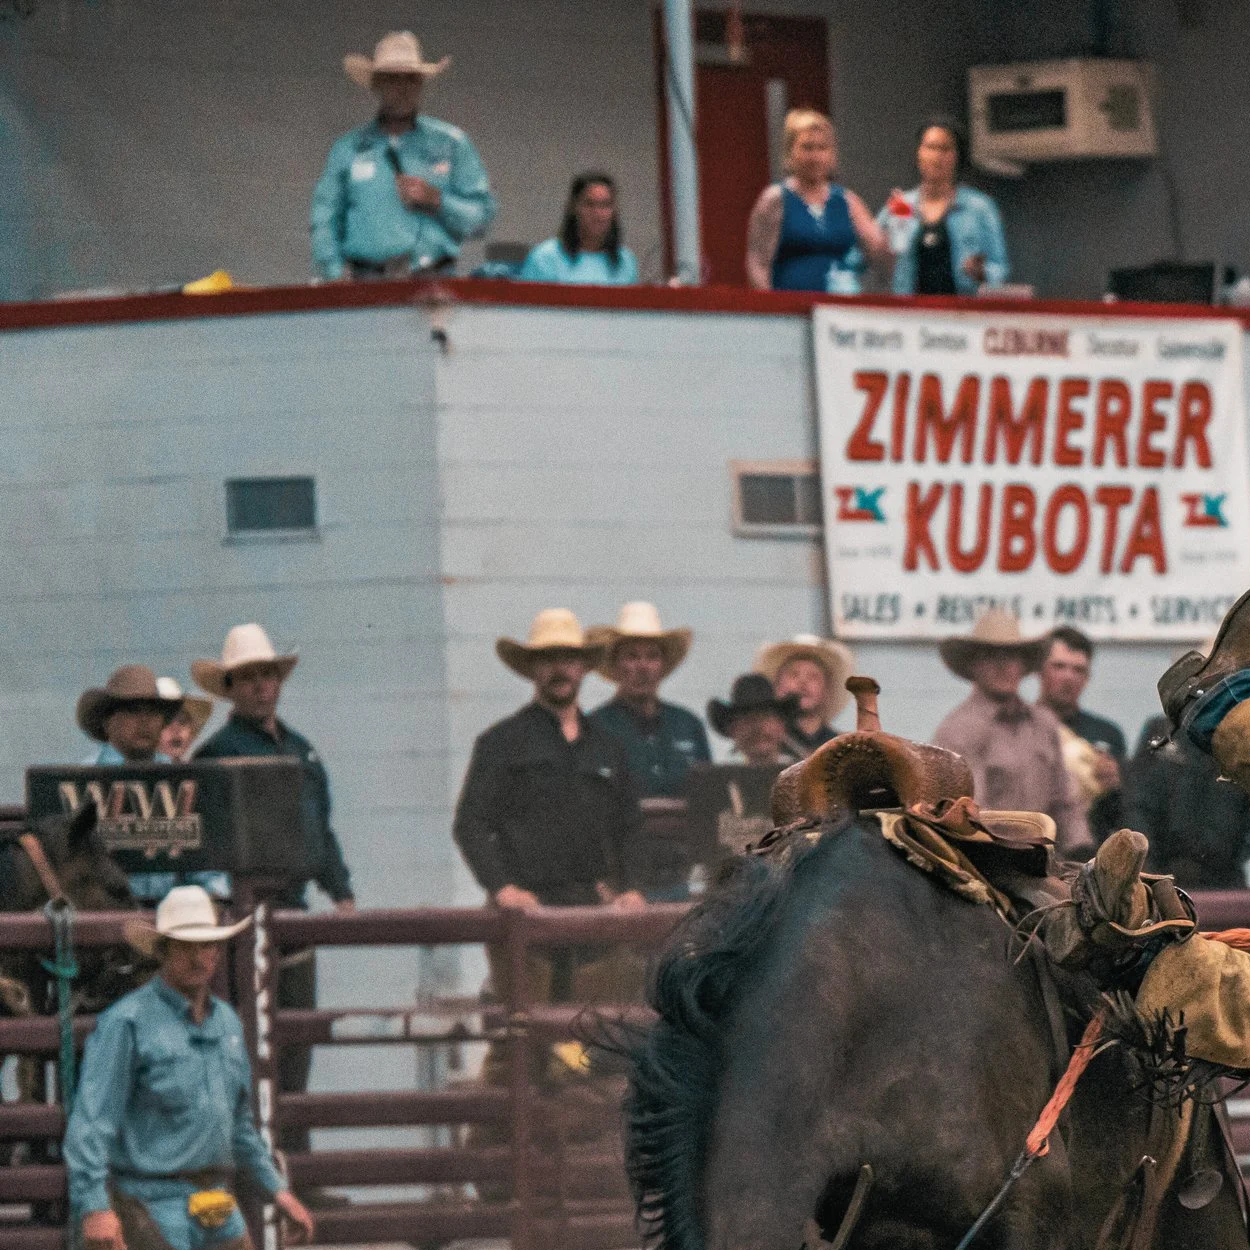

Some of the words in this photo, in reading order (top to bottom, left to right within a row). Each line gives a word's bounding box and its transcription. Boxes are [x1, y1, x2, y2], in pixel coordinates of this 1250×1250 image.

[846, 370, 1213, 469] ZIMMERER
[904, 481, 1167, 574] KUBOTA
[842, 592, 900, 624] SALES
[1151, 596, 1235, 625] SERVIC
